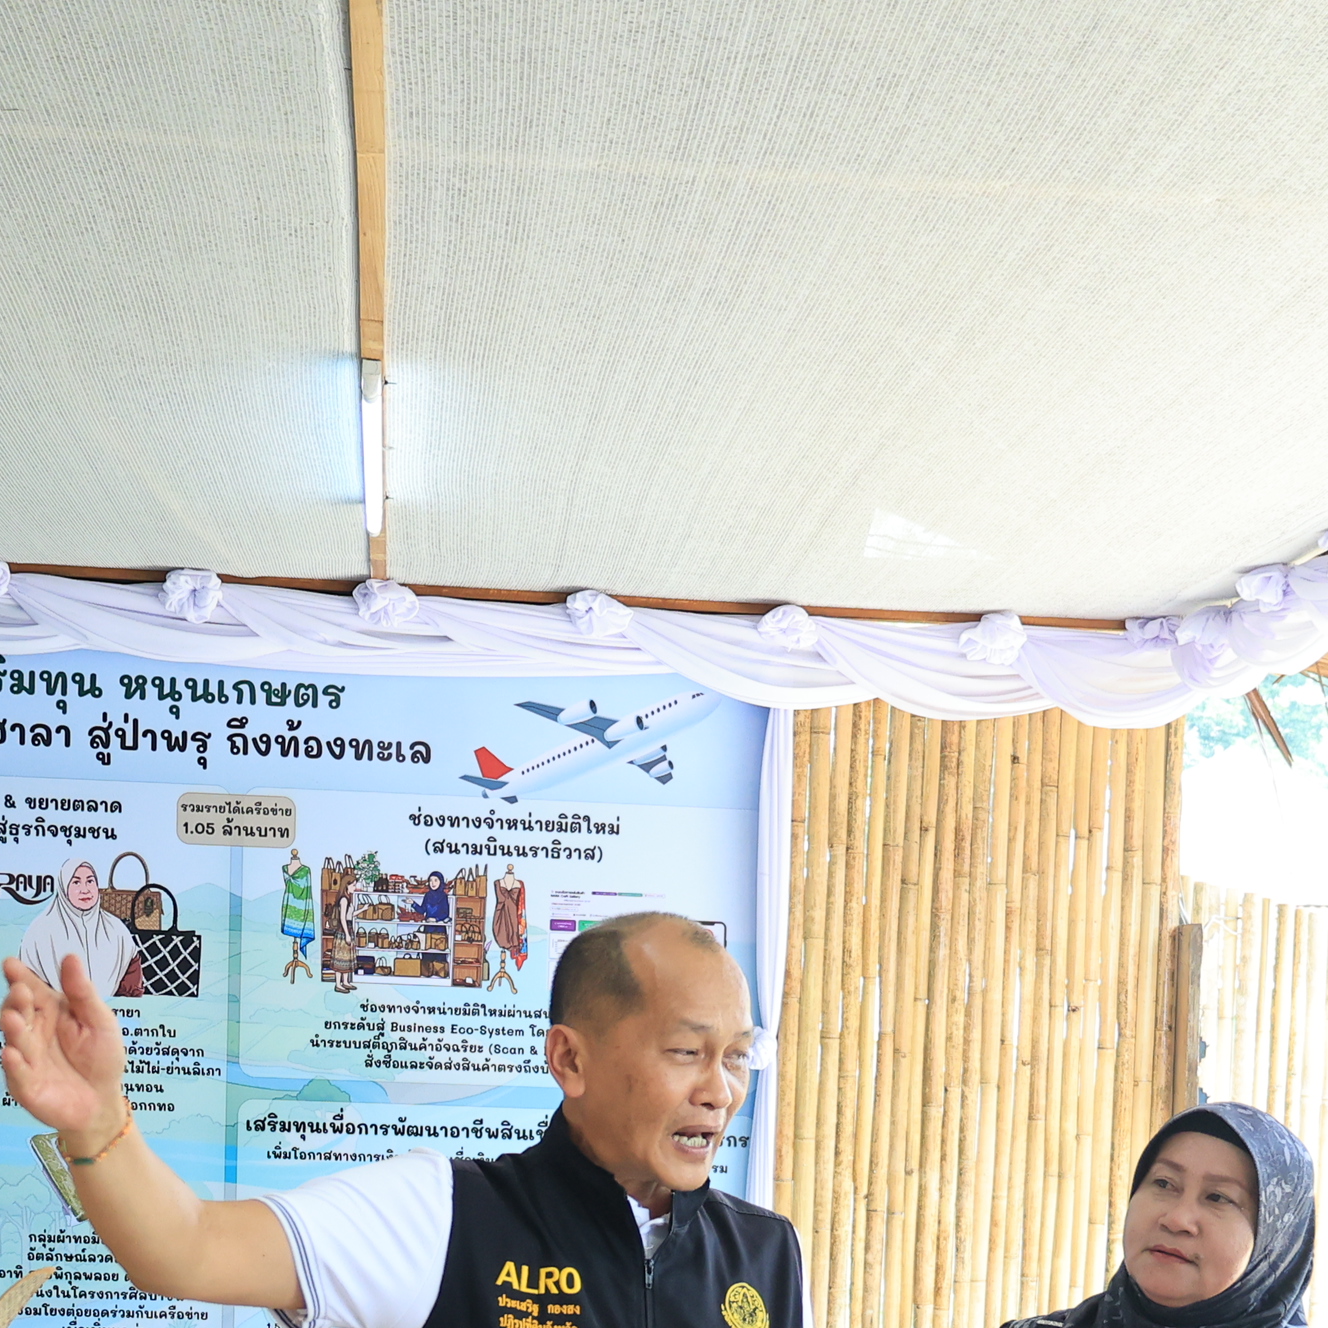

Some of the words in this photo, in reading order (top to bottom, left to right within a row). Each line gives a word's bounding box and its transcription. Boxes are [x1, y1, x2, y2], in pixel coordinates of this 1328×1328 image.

[119, 674, 346, 720] หนุนเกษตร
[88, 711, 212, 770] สู่ป่าพรุ
[226, 716, 432, 765] ถึงท้องทะเล
[4, 794, 17, 809] &
[25, 795, 123, 814] ขยายตลาด
[180, 801, 292, 818] รวมรายได้เครือข่าย
[182, 821, 215, 836] 1.05
[222, 816, 290, 839] ล้านบาท
[408, 807, 621, 836] ช่องทางจำหน่ายมิติใหม่
[424, 836, 604, 863] (สนามบินนราธิวาส)
[391, 1022, 446, 1034] Business
[450, 1024, 525, 1039] Eco-System
[488, 1043, 525, 1057] (Scan
[530, 1045, 539, 1056] &
[27, 1247, 118, 1264] อัตลักษณ์ลวด
[495, 1260, 582, 1295] ALRO
